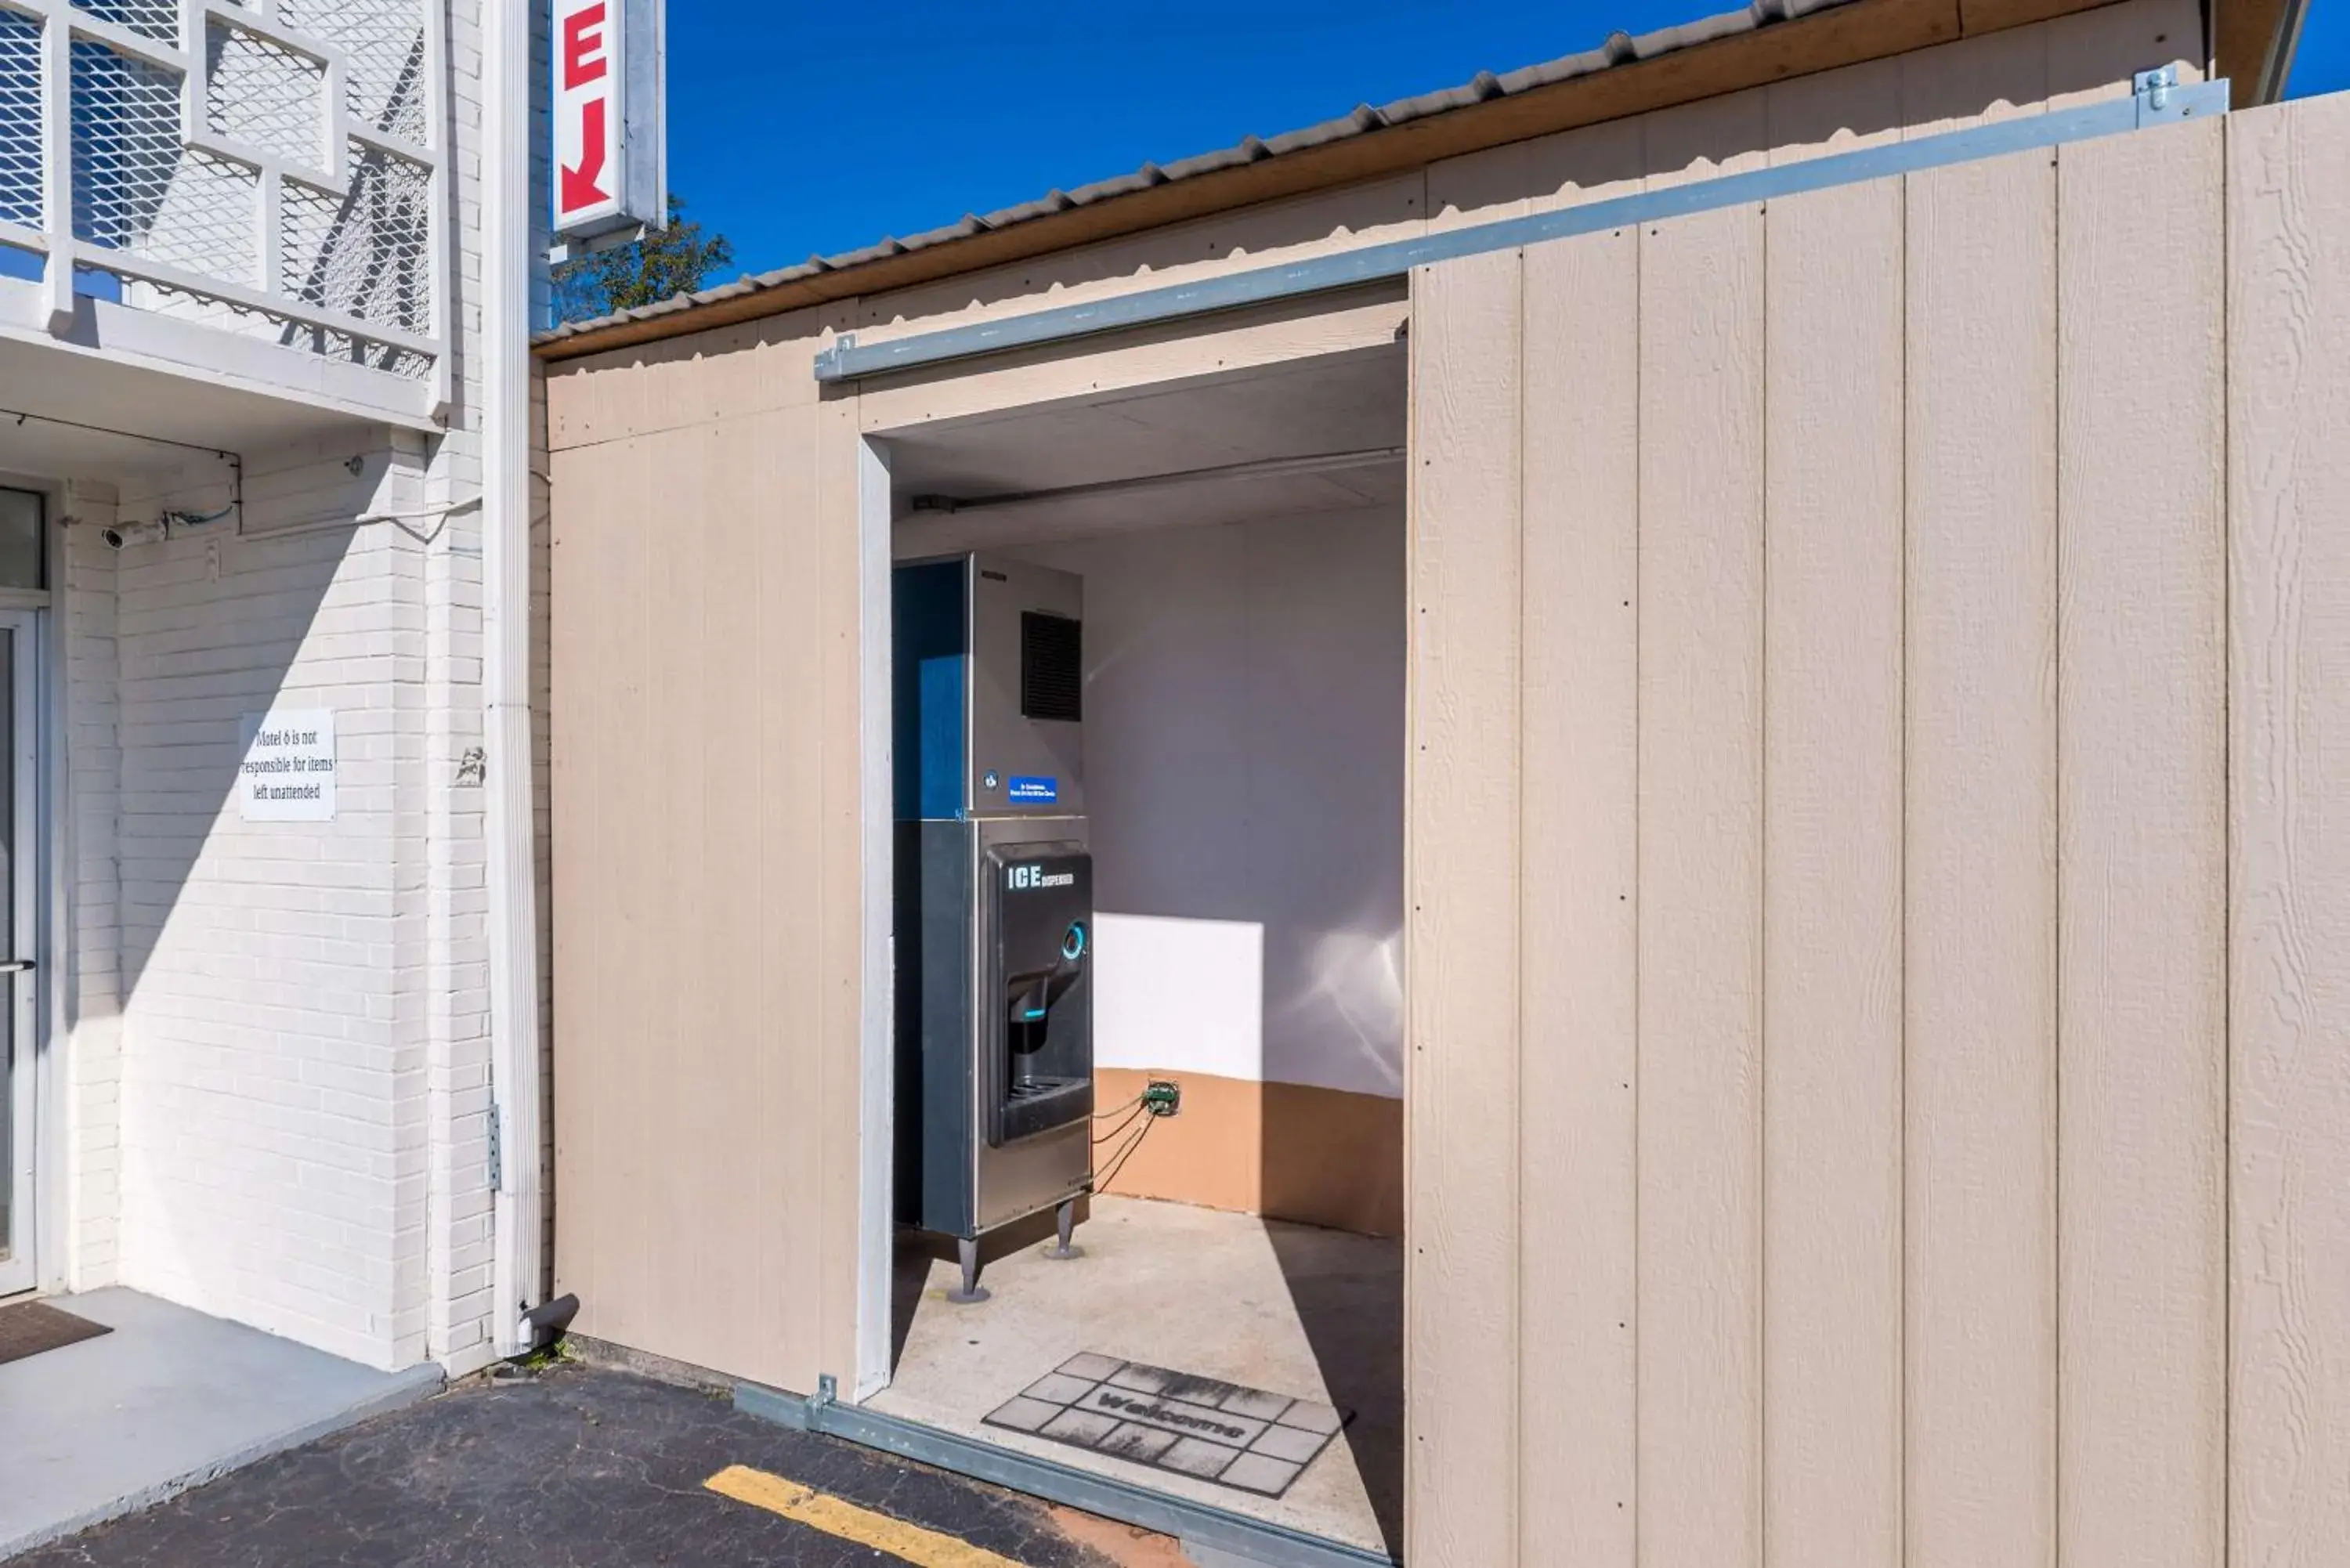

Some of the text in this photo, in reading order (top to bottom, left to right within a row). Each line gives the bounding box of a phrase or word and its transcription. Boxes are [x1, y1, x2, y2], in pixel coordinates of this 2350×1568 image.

[564, 2, 607, 91] E
[257, 729, 317, 746] Motel 6 is not
[240, 756, 333, 777] responsible for items
[253, 783, 320, 800] left unattended
[1008, 865, 1041, 889] ICE
